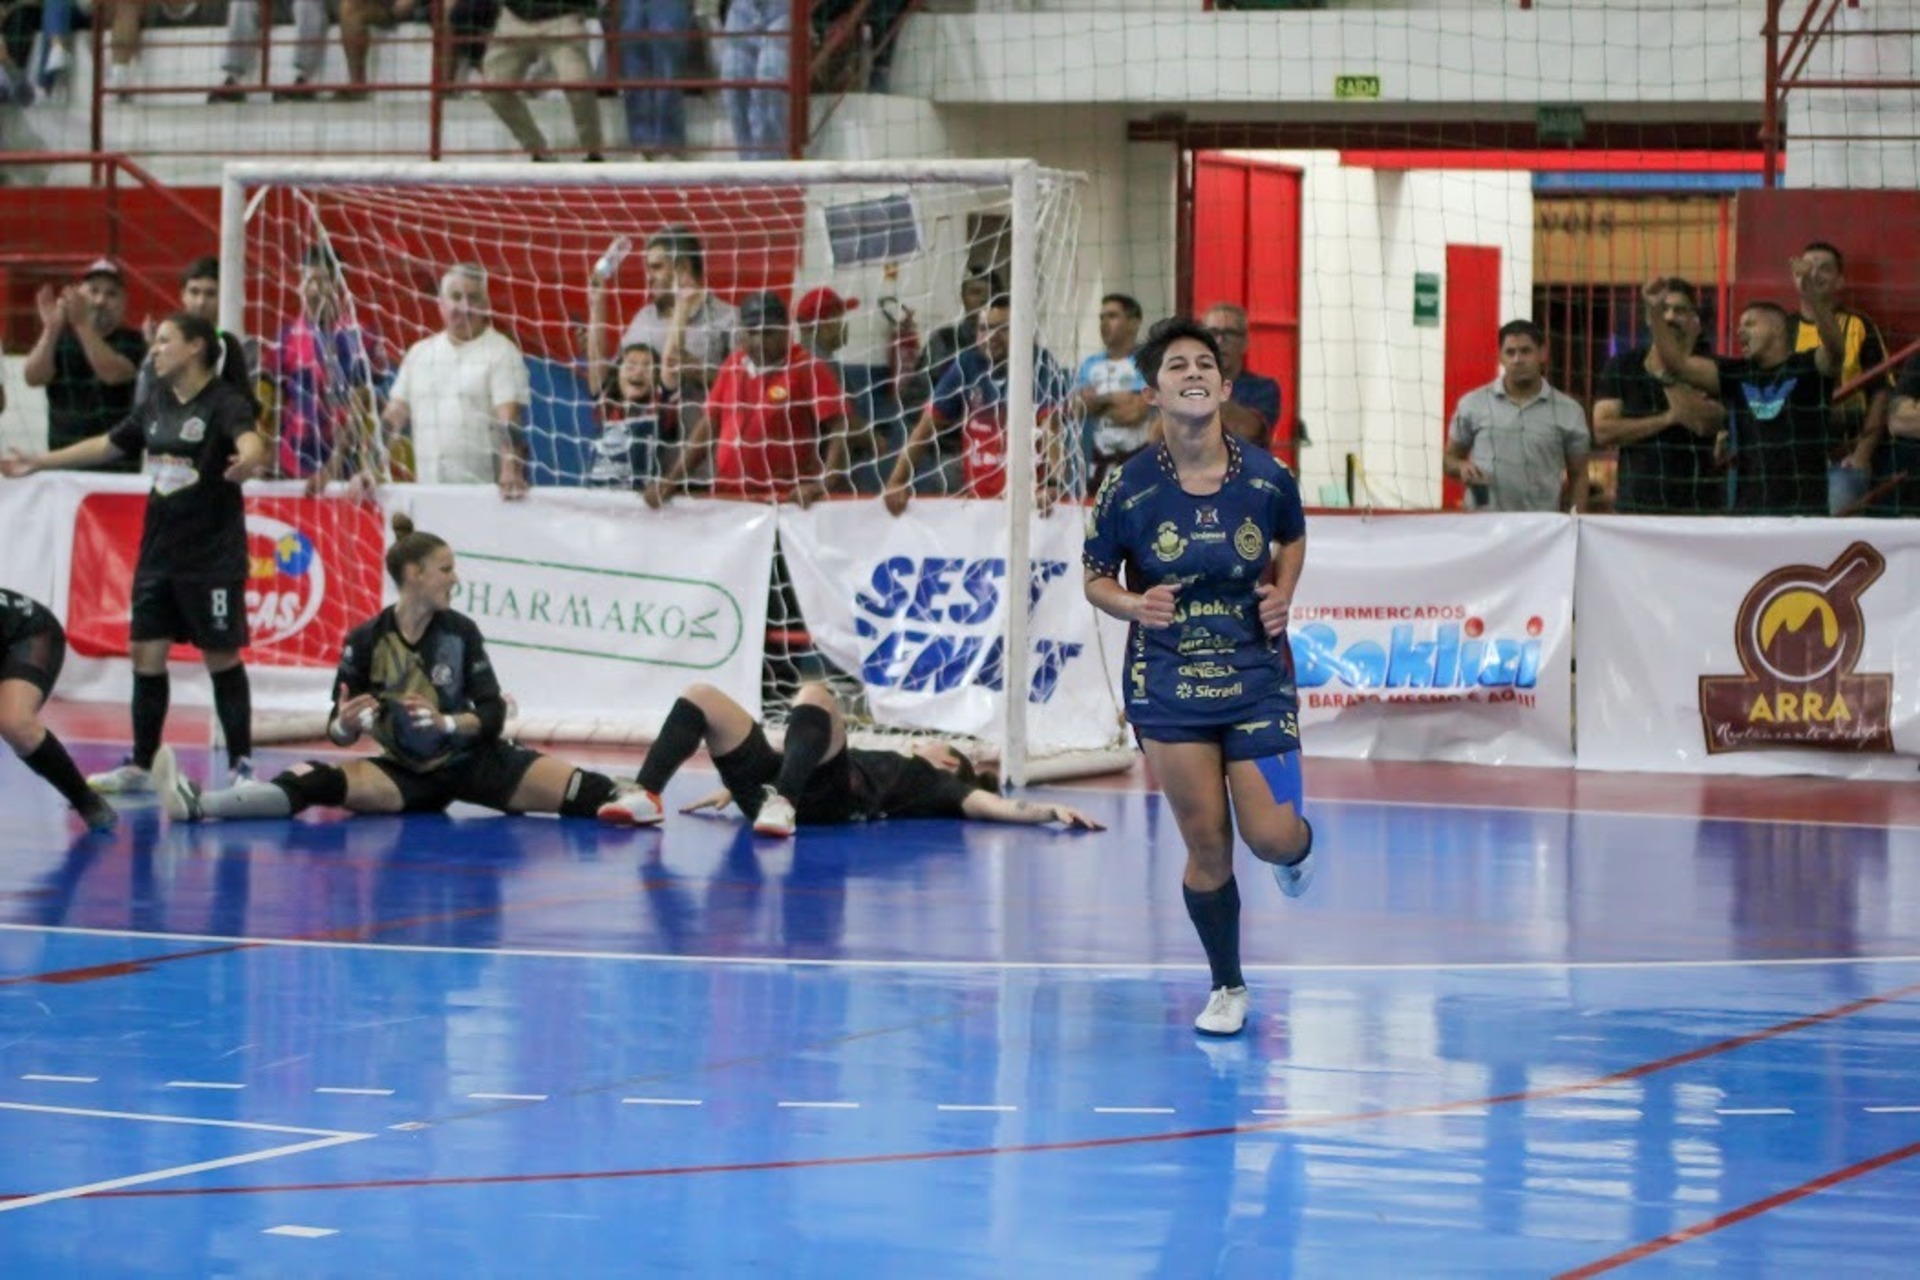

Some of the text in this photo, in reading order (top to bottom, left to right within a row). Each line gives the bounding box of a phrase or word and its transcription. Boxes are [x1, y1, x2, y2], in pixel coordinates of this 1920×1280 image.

[212, 588, 228, 617] 8
[1293, 605, 1466, 621] SUPERMERCADOS
[1195, 682, 1243, 698] Sicredi
[1749, 692, 1852, 722] ARRA
